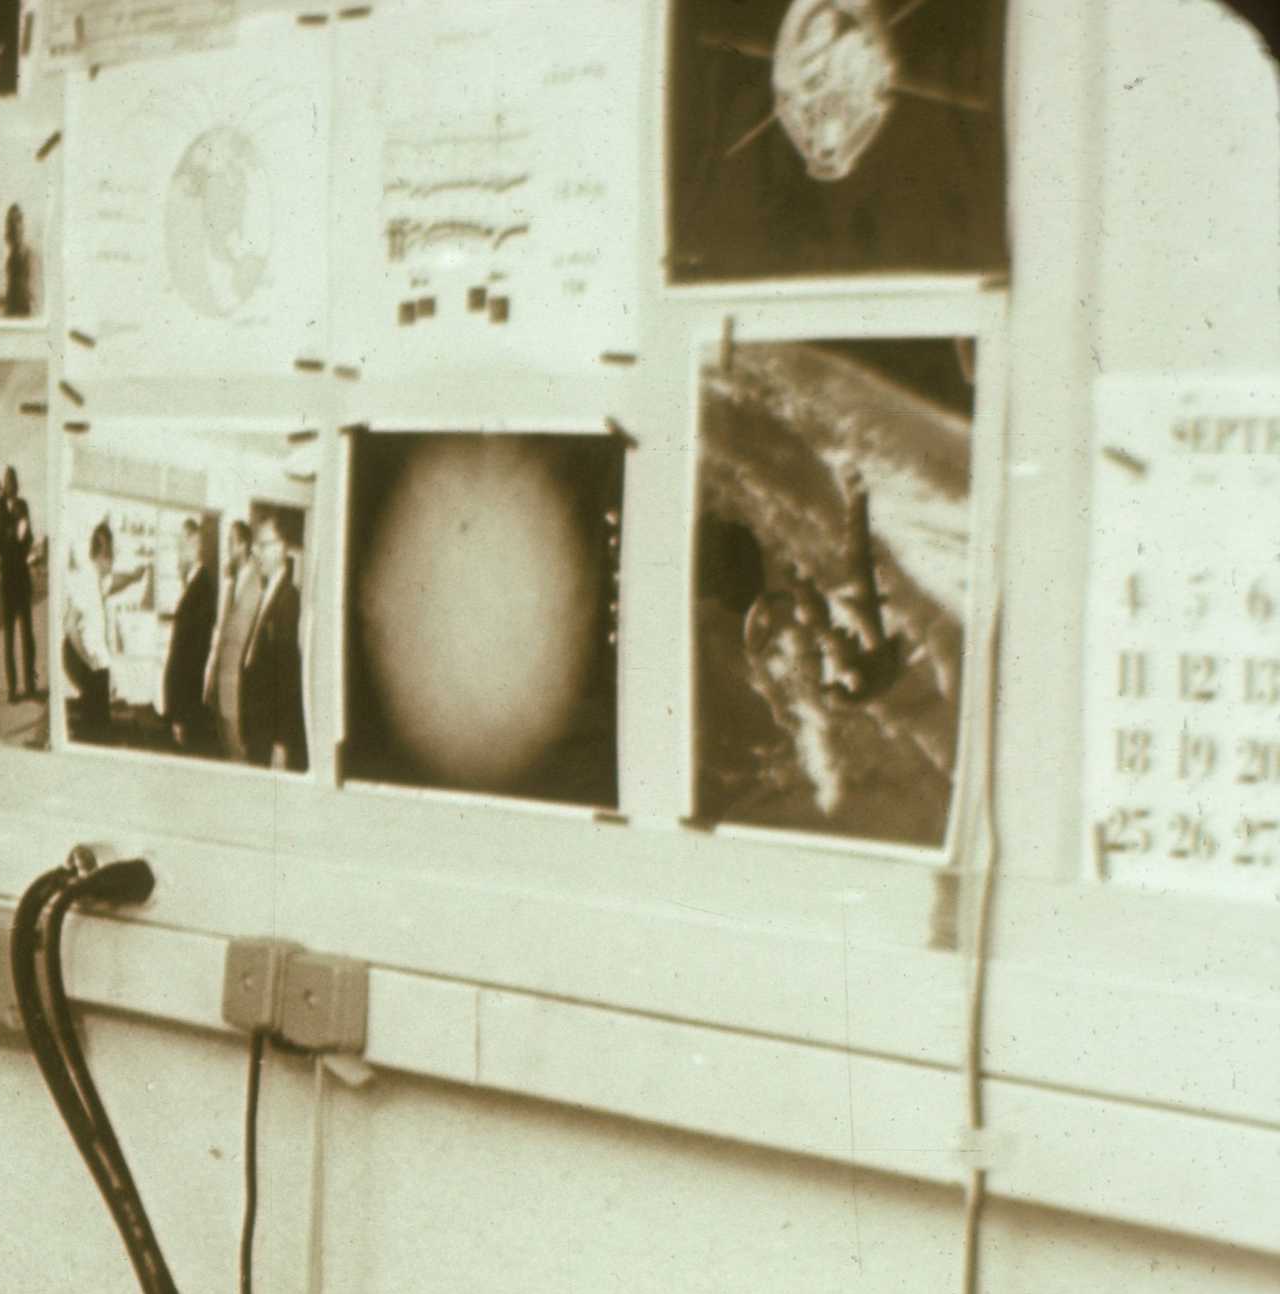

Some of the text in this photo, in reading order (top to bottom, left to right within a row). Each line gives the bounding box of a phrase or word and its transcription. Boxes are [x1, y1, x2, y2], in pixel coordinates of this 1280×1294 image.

[1245, 576, 1276, 625] 6
[1117, 648, 1149, 700] 11
[1178, 650, 1218, 703] 12
[1115, 727, 1154, 776] 18
[1178, 731, 1218, 781] 19
[1107, 806, 1155, 855] 25
[1169, 812, 1220, 861] 26
